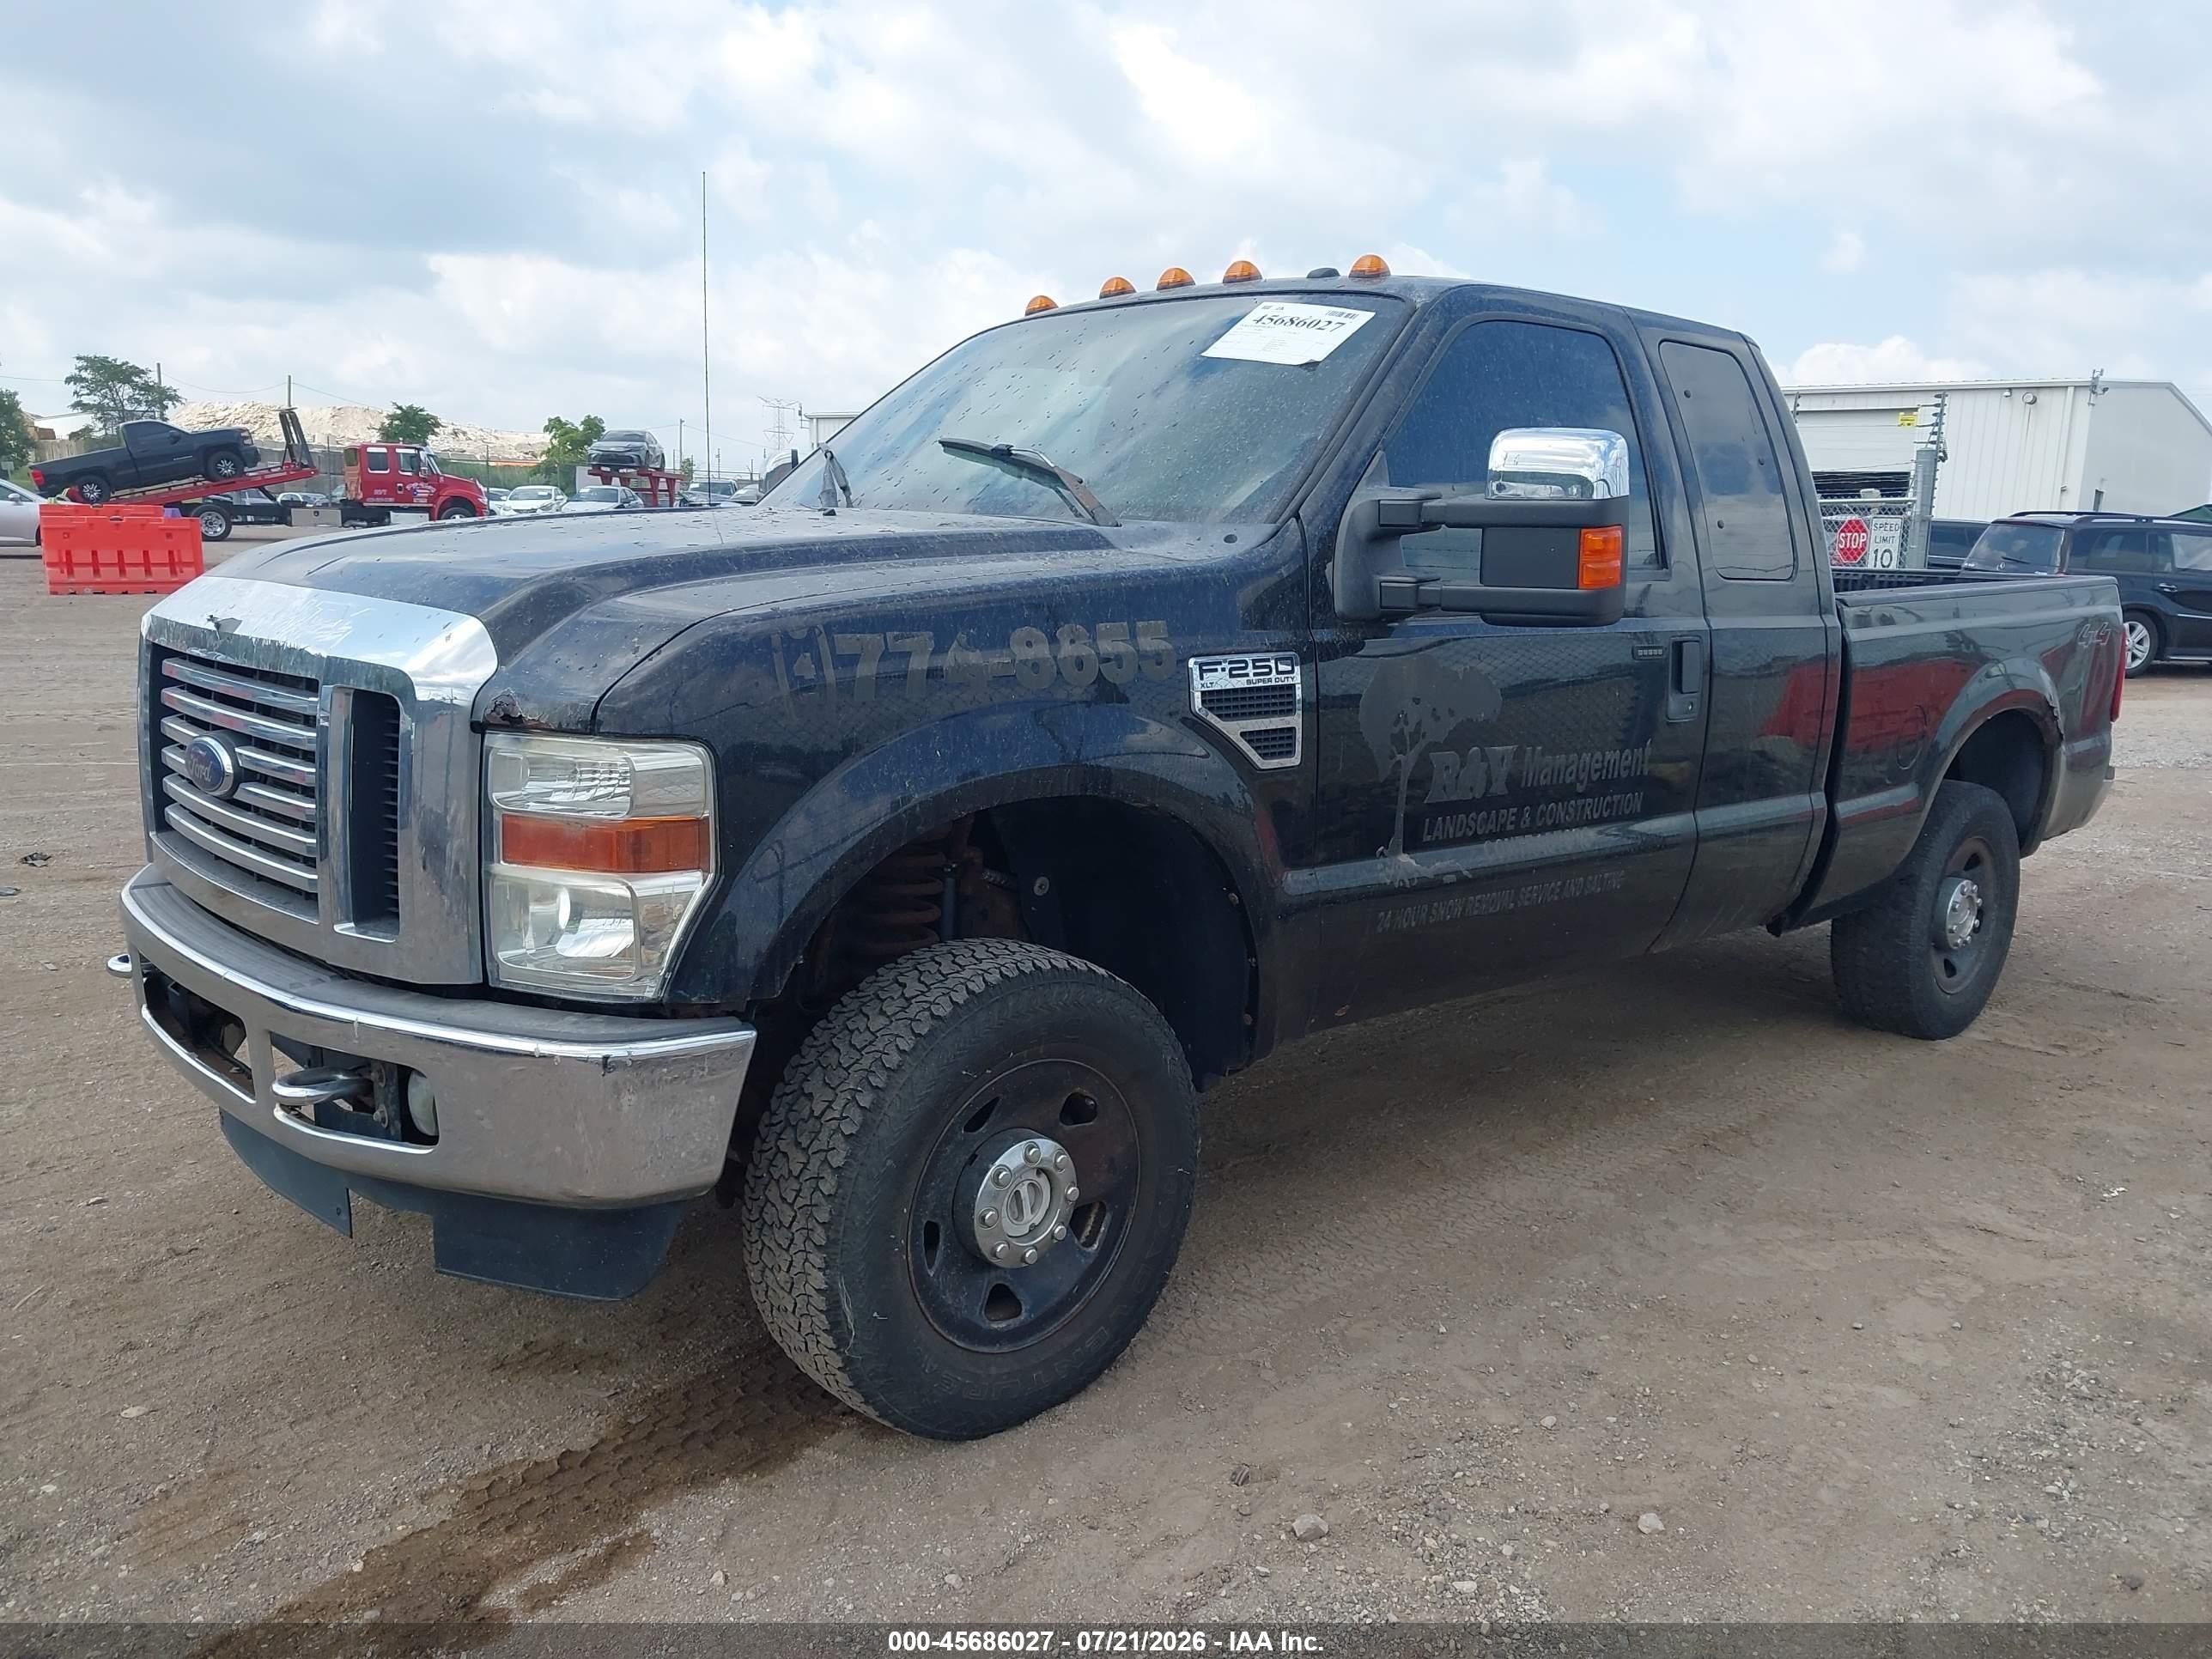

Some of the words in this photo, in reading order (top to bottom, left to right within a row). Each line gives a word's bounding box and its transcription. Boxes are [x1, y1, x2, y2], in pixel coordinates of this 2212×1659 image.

[1253, 314, 1346, 332] 45686027
[1874, 522, 1899, 532] SPEED
[1839, 532, 1867, 549] STOP
[1873, 549, 1893, 568] 10
[1521, 738, 1652, 793] Management
[1423, 807, 1517, 842] LANDSCAPE
[1521, 805, 1531, 828] &
[1536, 792, 1644, 827] CONSTRUCTION
[1393, 904, 1428, 928] HOUR
[1430, 899, 1462, 922] SNOW
[1516, 880, 1561, 907] SERVICE
